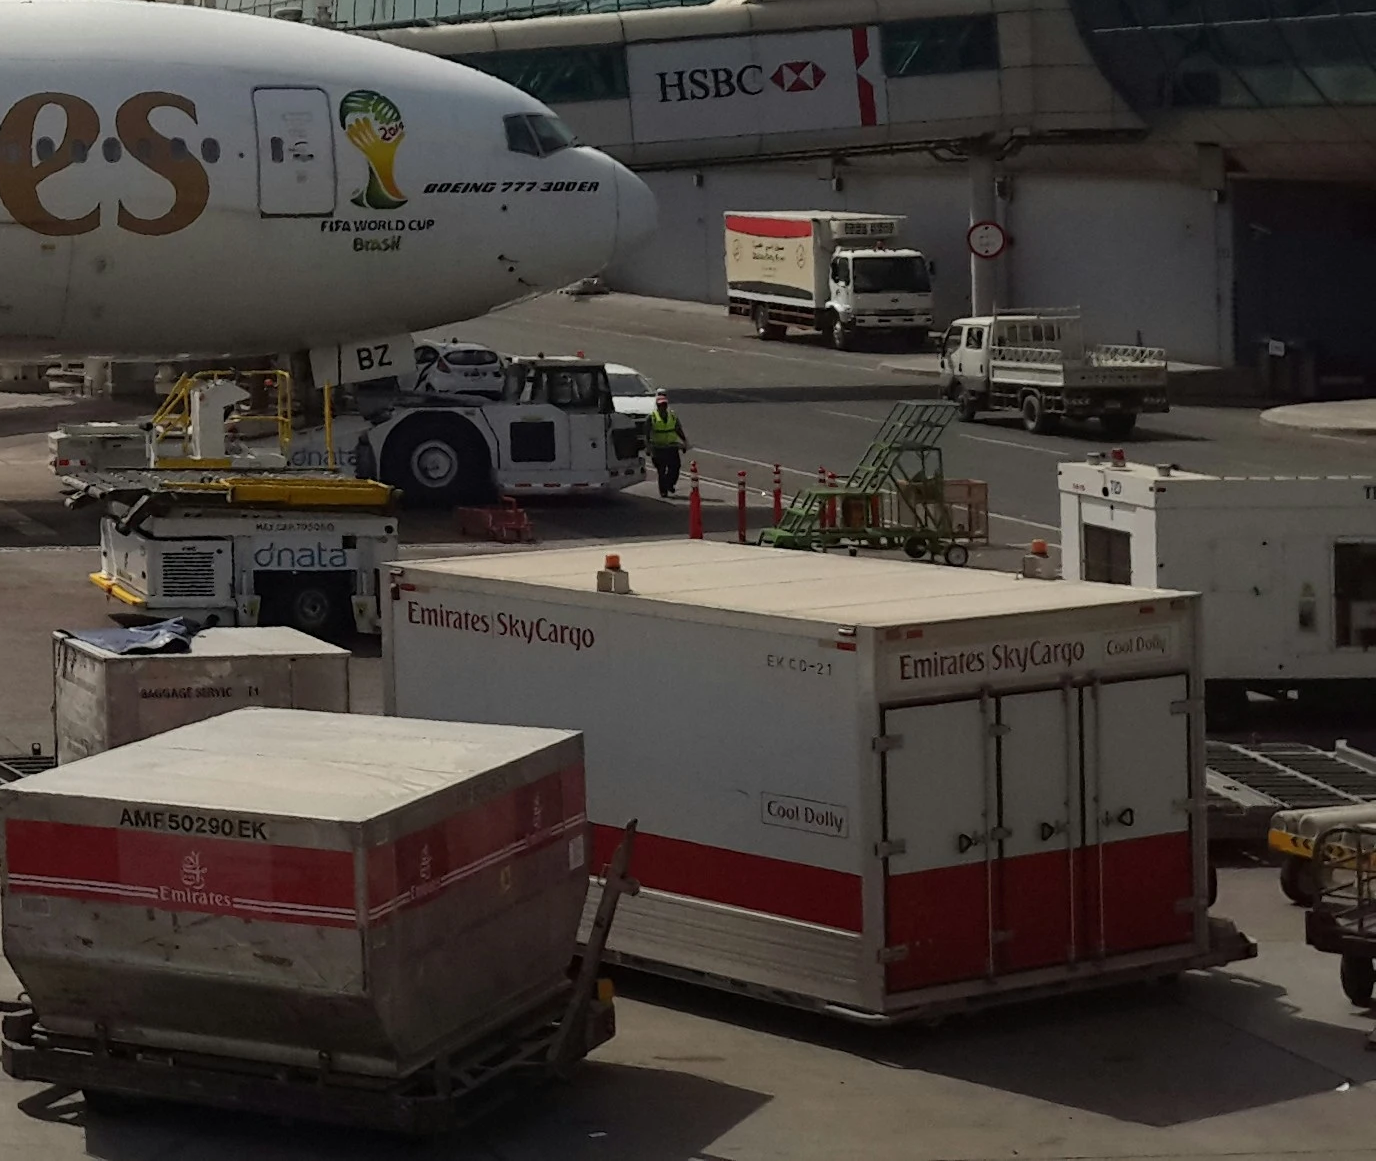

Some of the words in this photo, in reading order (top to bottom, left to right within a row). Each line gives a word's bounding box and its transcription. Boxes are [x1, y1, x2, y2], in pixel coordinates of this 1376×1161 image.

[656, 65, 763, 102] HSBC
[423, 182, 497, 194] BOEING
[320, 220, 351, 232] FIFA
[353, 219, 406, 232] WORLD
[408, 219, 435, 231] CUP
[352, 236, 402, 252] Brasil
[356, 343, 393, 370] BZ
[254, 542, 348, 568] dnata
[407, 601, 490, 633] Emirates
[497, 612, 595, 651] SkyCargo
[899, 652, 985, 680] Emirates
[991, 640, 1085, 673] SkyCargo
[1106, 638, 1133, 656] Cool
[141, 686, 192, 699] BAGGAGE
[167, 814, 234, 837] 50290
[238, 819, 268, 840] EK
[767, 800, 800, 821] Cool
[804, 806, 843, 833] Dolly
[158, 885, 232, 907] Emirates
